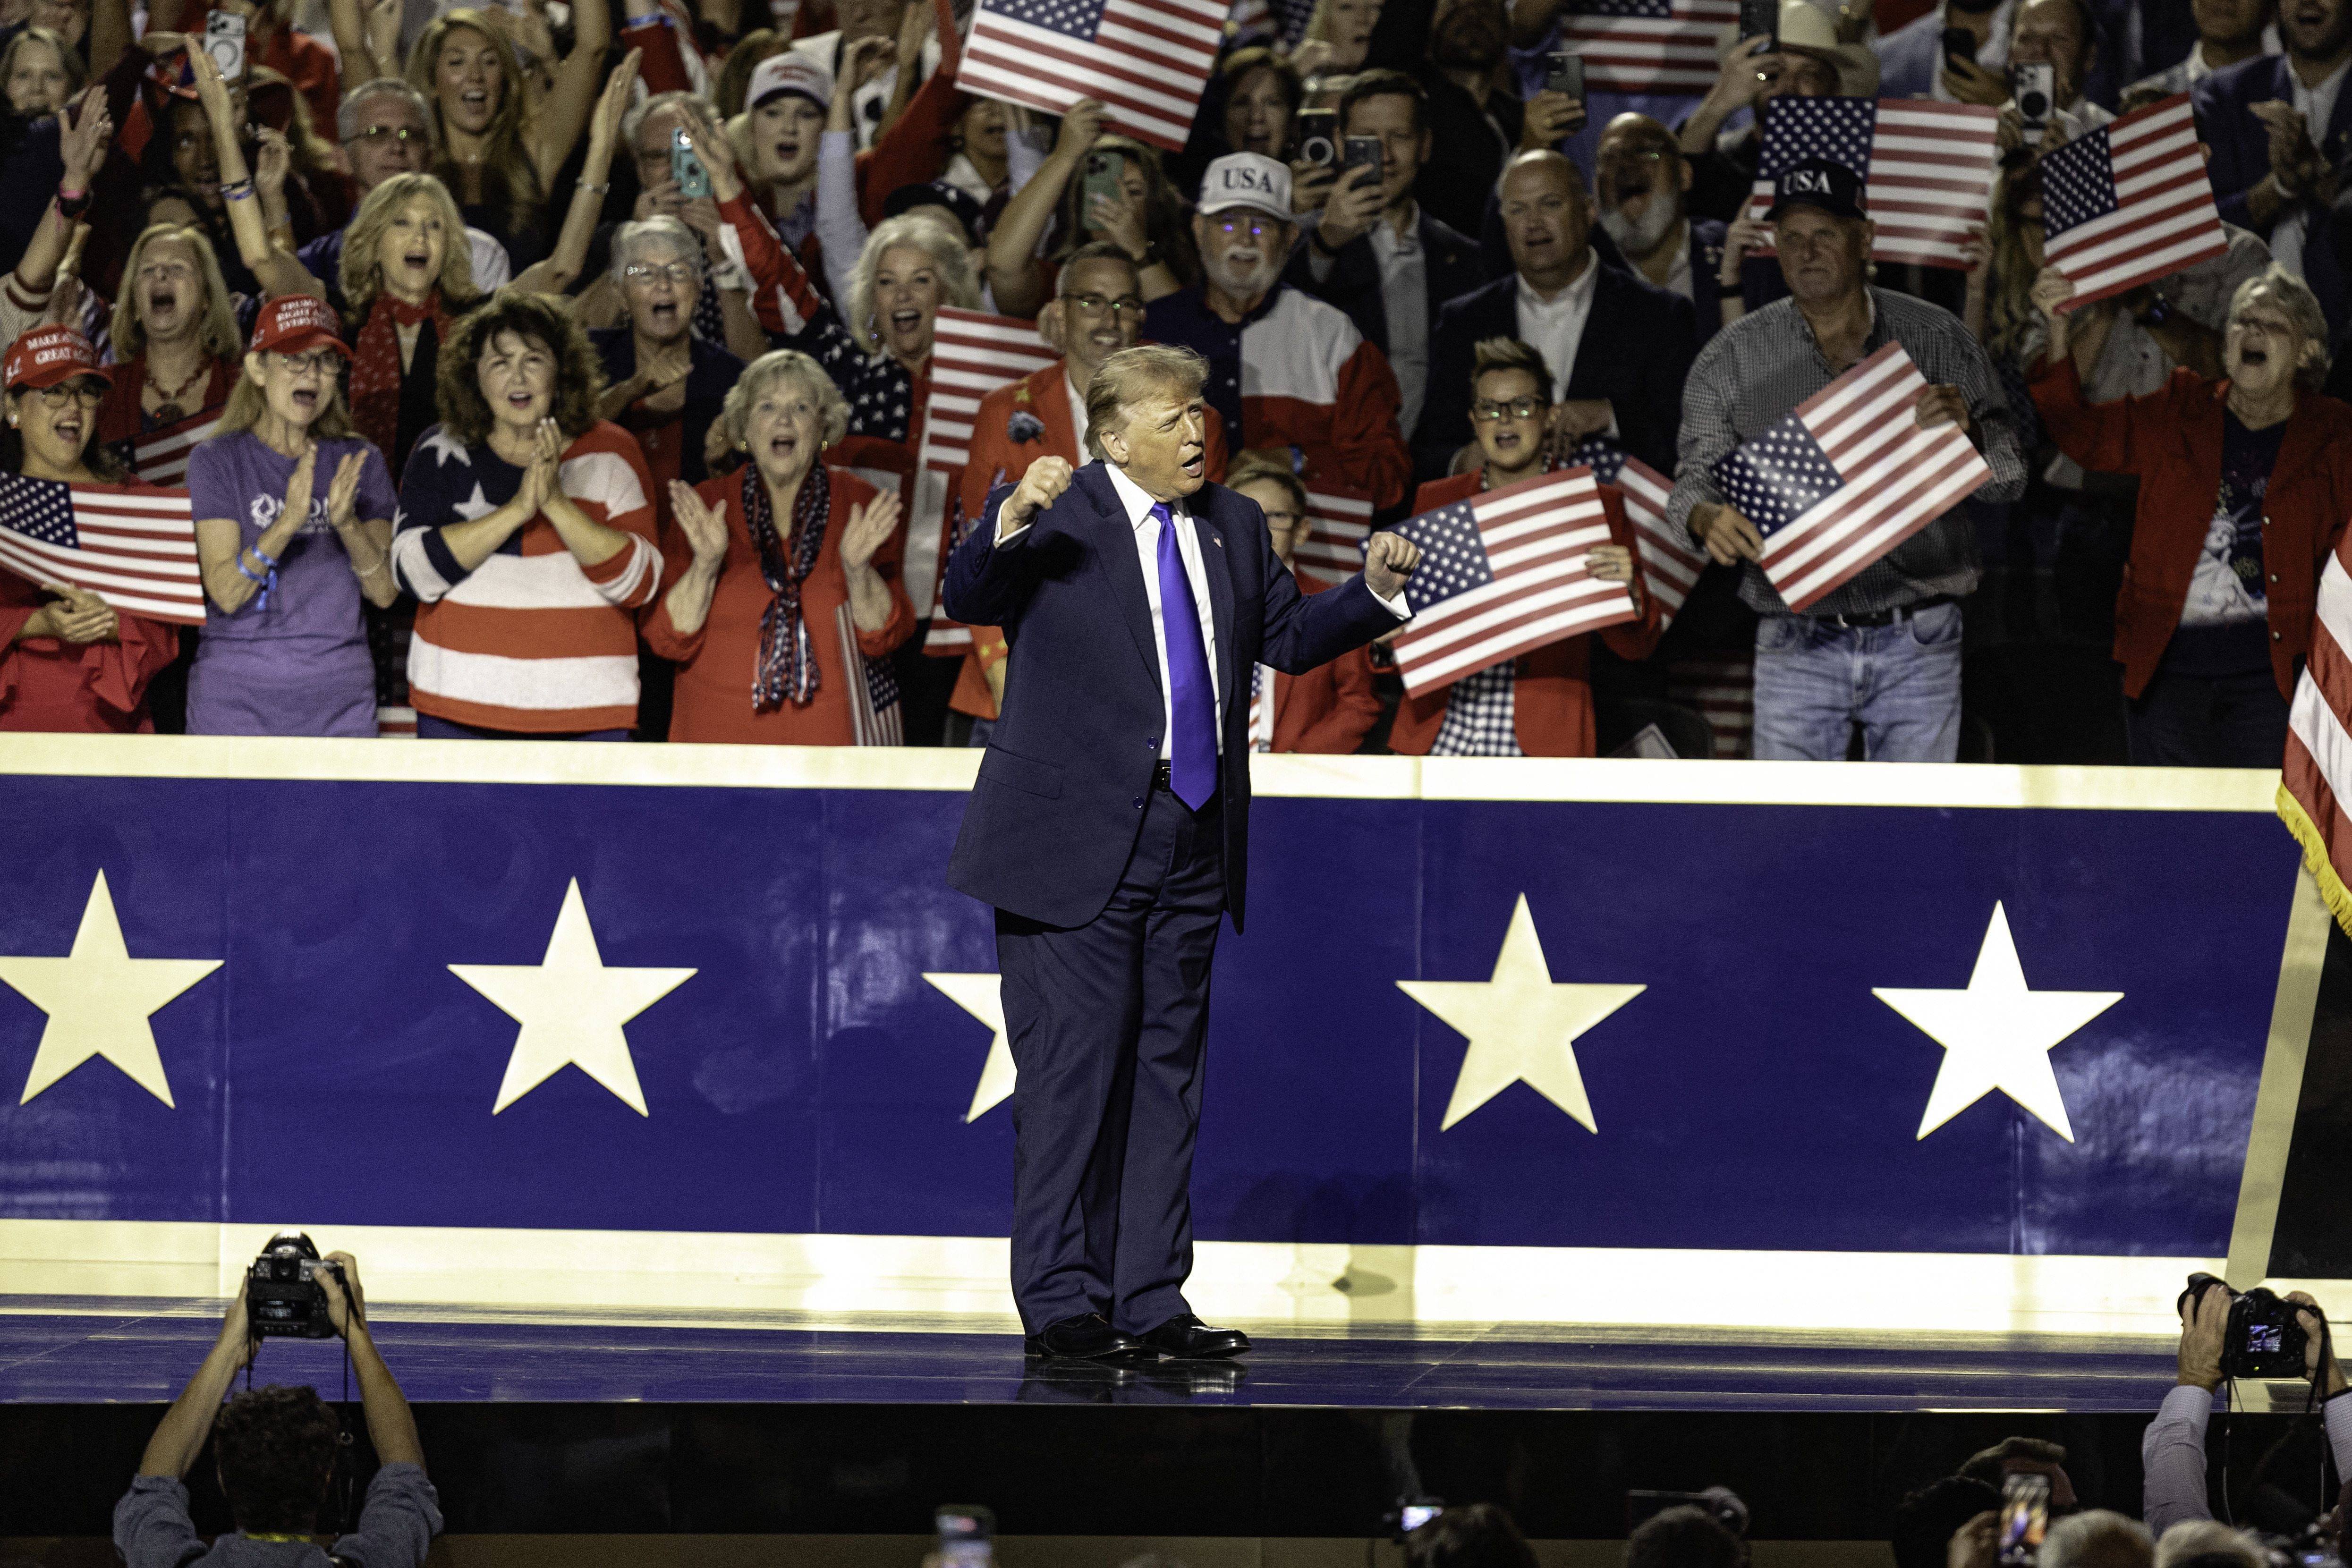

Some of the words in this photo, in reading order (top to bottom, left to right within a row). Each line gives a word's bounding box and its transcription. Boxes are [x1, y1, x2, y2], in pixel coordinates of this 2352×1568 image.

[1223, 168, 1273, 193] USA
[1783, 170, 1832, 195] USA
[26, 332, 59, 351] MAKE
[35, 347, 71, 365] GREAT
